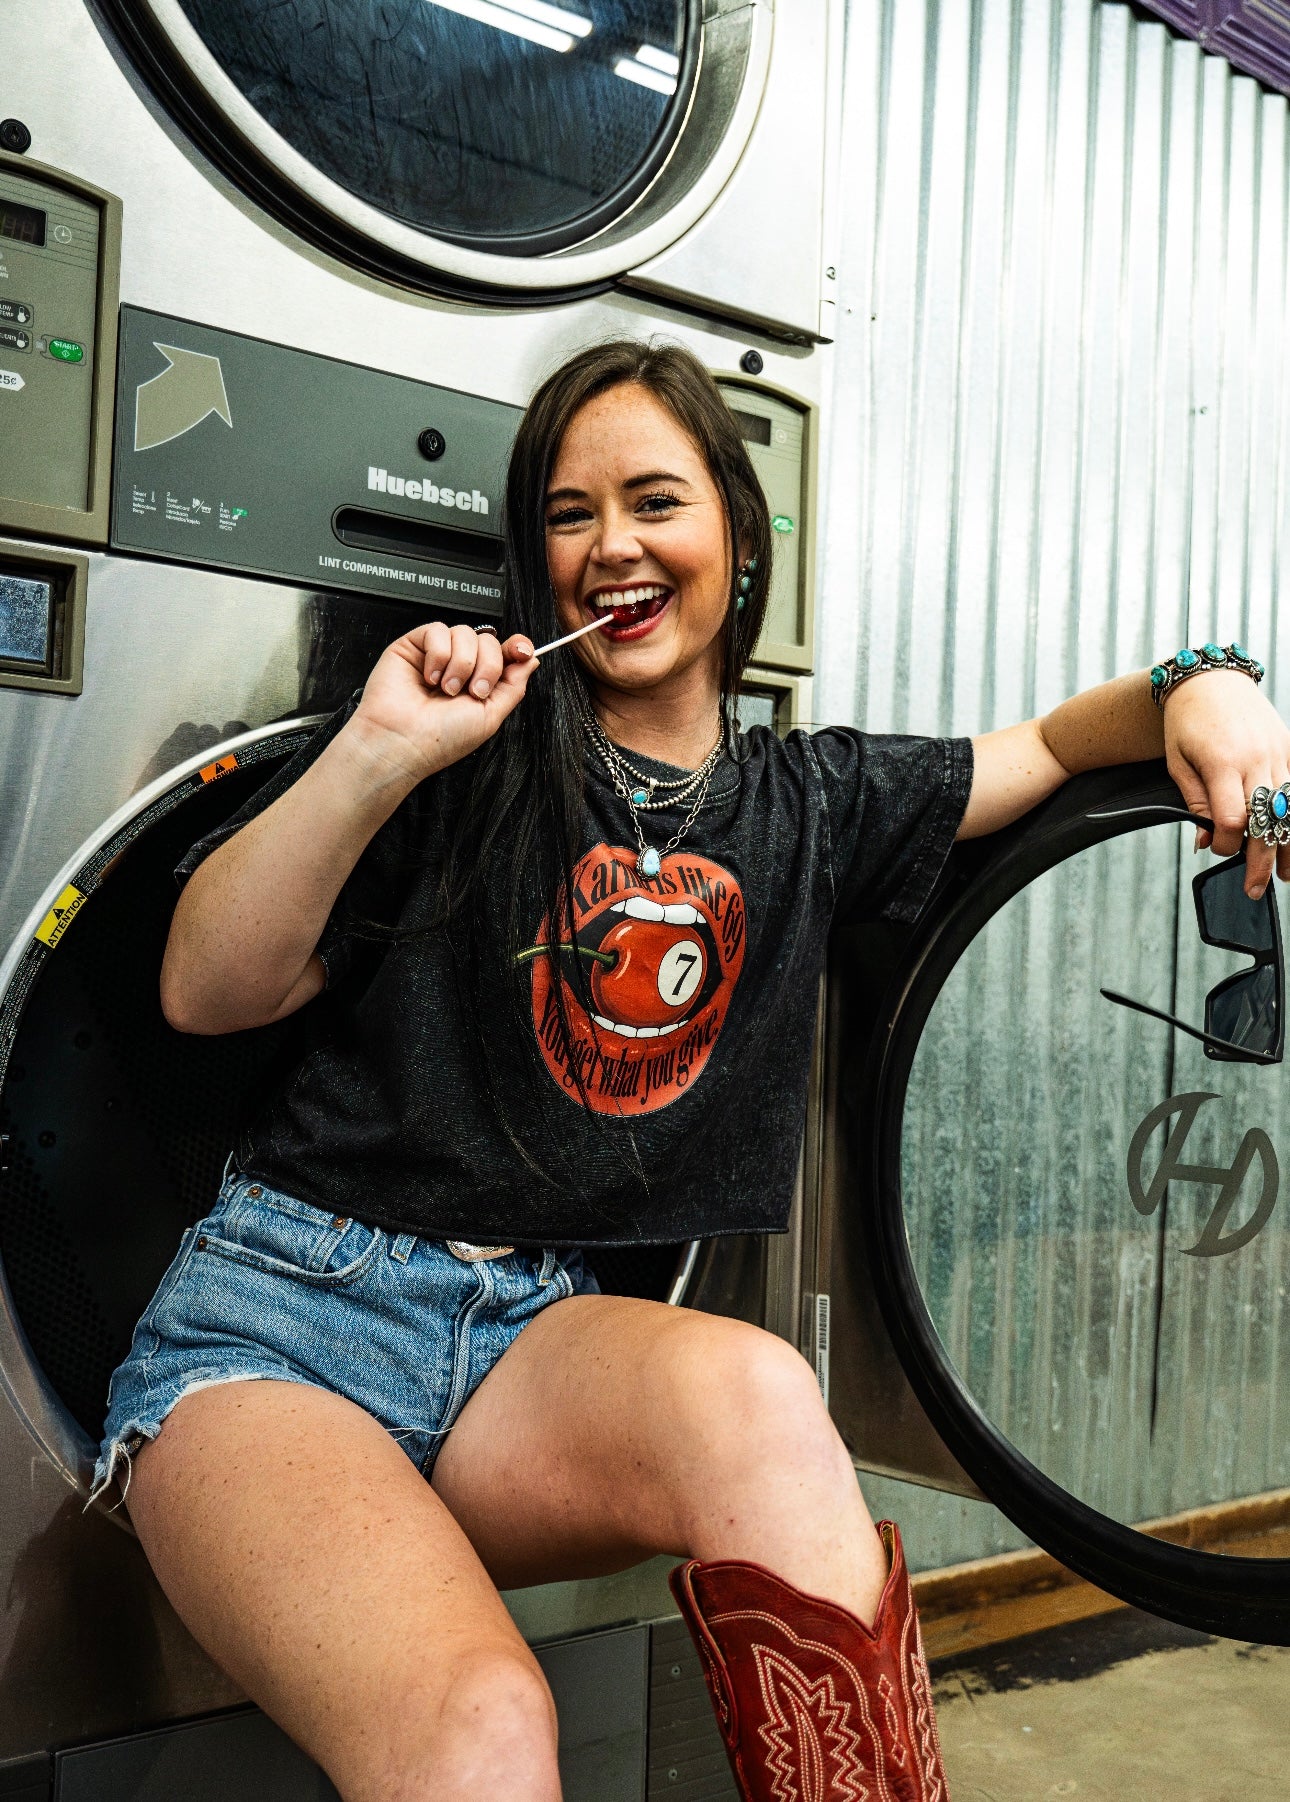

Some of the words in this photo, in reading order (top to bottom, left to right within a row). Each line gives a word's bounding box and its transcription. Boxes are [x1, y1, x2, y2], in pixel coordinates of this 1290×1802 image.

[367, 466, 489, 515] Huebsch
[318, 555, 342, 570] LINT
[342, 560, 417, 583] COMPARTMENT
[418, 574, 445, 588] MUST
[446, 579, 459, 591] BE
[460, 582, 502, 598] CLEANED
[675, 865, 727, 921] like
[48, 892, 86, 947] ATTENTION
[671, 953, 698, 996] 7
[598, 1045, 646, 1098] what
[640, 1047, 677, 1105] you
